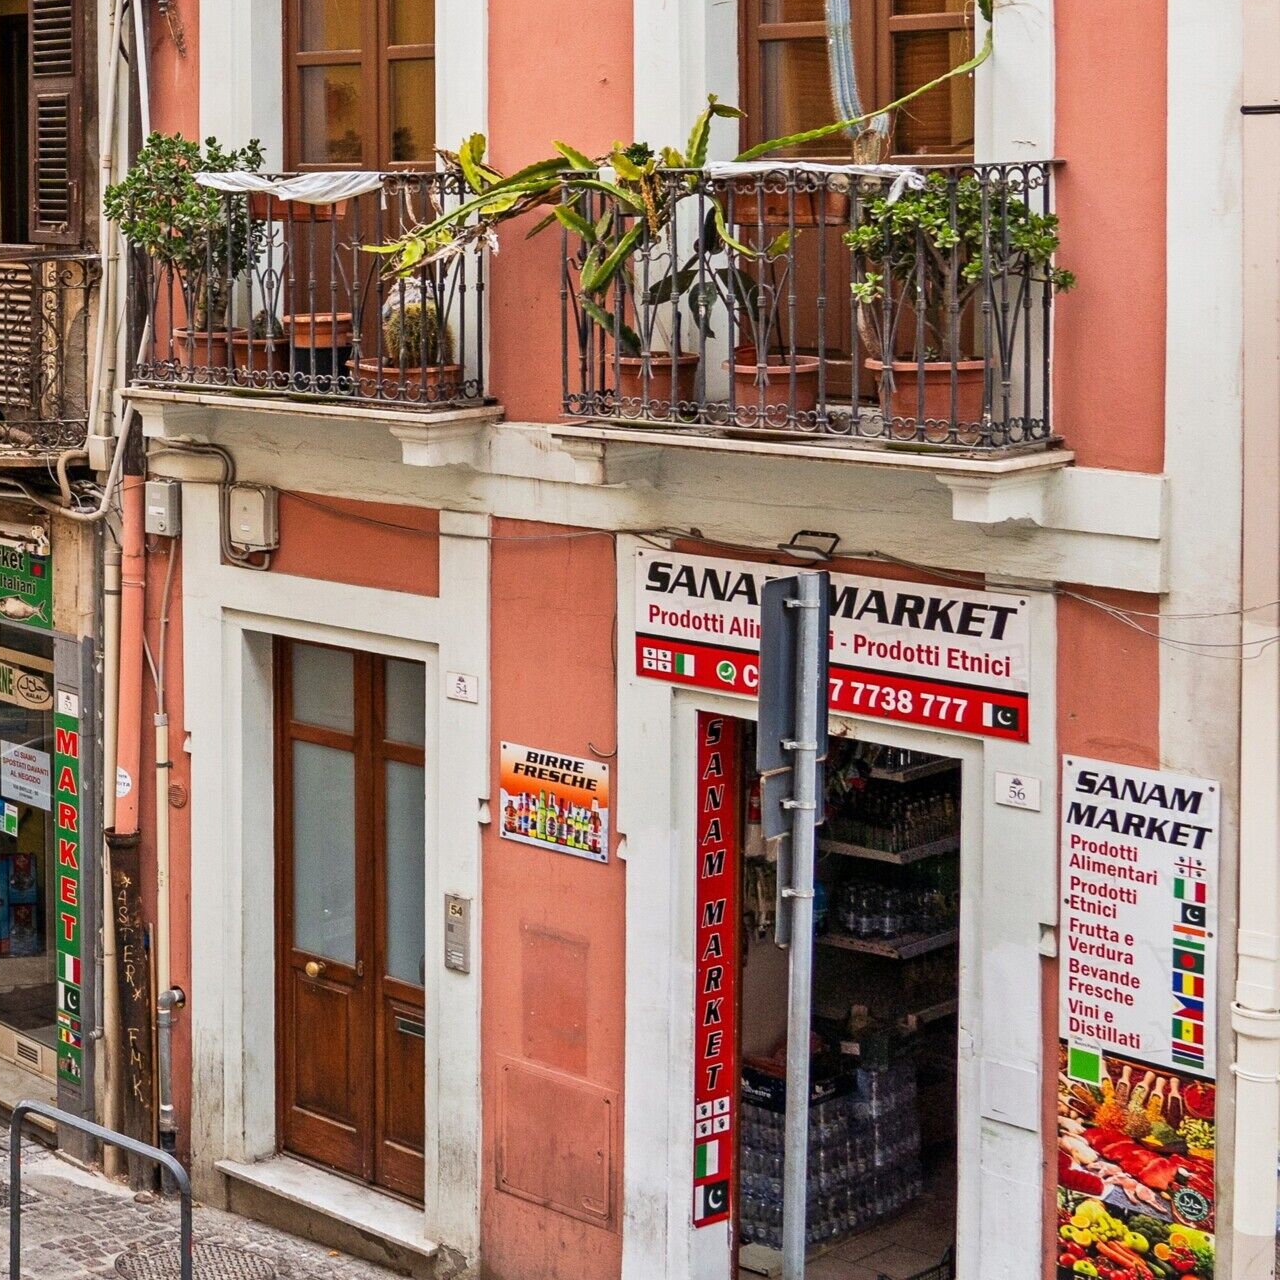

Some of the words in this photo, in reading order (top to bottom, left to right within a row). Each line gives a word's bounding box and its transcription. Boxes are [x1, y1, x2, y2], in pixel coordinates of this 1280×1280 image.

[0, 575, 36, 595] Italiani
[645, 561, 778, 607] SANA
[649, 604, 724, 634] Prodotti
[853, 634, 939, 667] Prodotti
[947, 647, 1011, 677] Etnici
[455, 682, 468, 695] 54
[850, 681, 913, 714] 7738
[920, 692, 968, 723] 777
[2, 756, 26, 770] SPOSTATI
[27, 764, 49, 777] DAVANTI
[20, 751, 37, 763] SIAMO
[525, 751, 584, 773] BIRRE
[18, 772, 41, 785] NEGOZIO
[513, 763, 598, 791] FRESCHE
[702, 719, 726, 879] SANAM
[1009, 786, 1026, 800] 56
[1075, 770, 1203, 815] SANAM
[56, 727, 78, 942] MARKET
[1066, 801, 1213, 850] MARKET
[1070, 834, 1138, 862] Prodotti
[1069, 853, 1158, 886] Alimentari
[1070, 876, 1137, 905] Prodotti
[450, 904, 463, 917] 54
[1069, 894, 1117, 919] Etnici
[1069, 917, 1119, 943] Frutta
[1124, 933, 1135, 946] e
[1068, 935, 1134, 965] Verdura
[1069, 957, 1140, 989] Bevande
[701, 897, 727, 1091] MARKET
[1069, 976, 1134, 1006] Fresche
[1068, 998, 1099, 1020] Vini
[1104, 1010, 1114, 1023] e
[1069, 1017, 1140, 1050] Distillati
